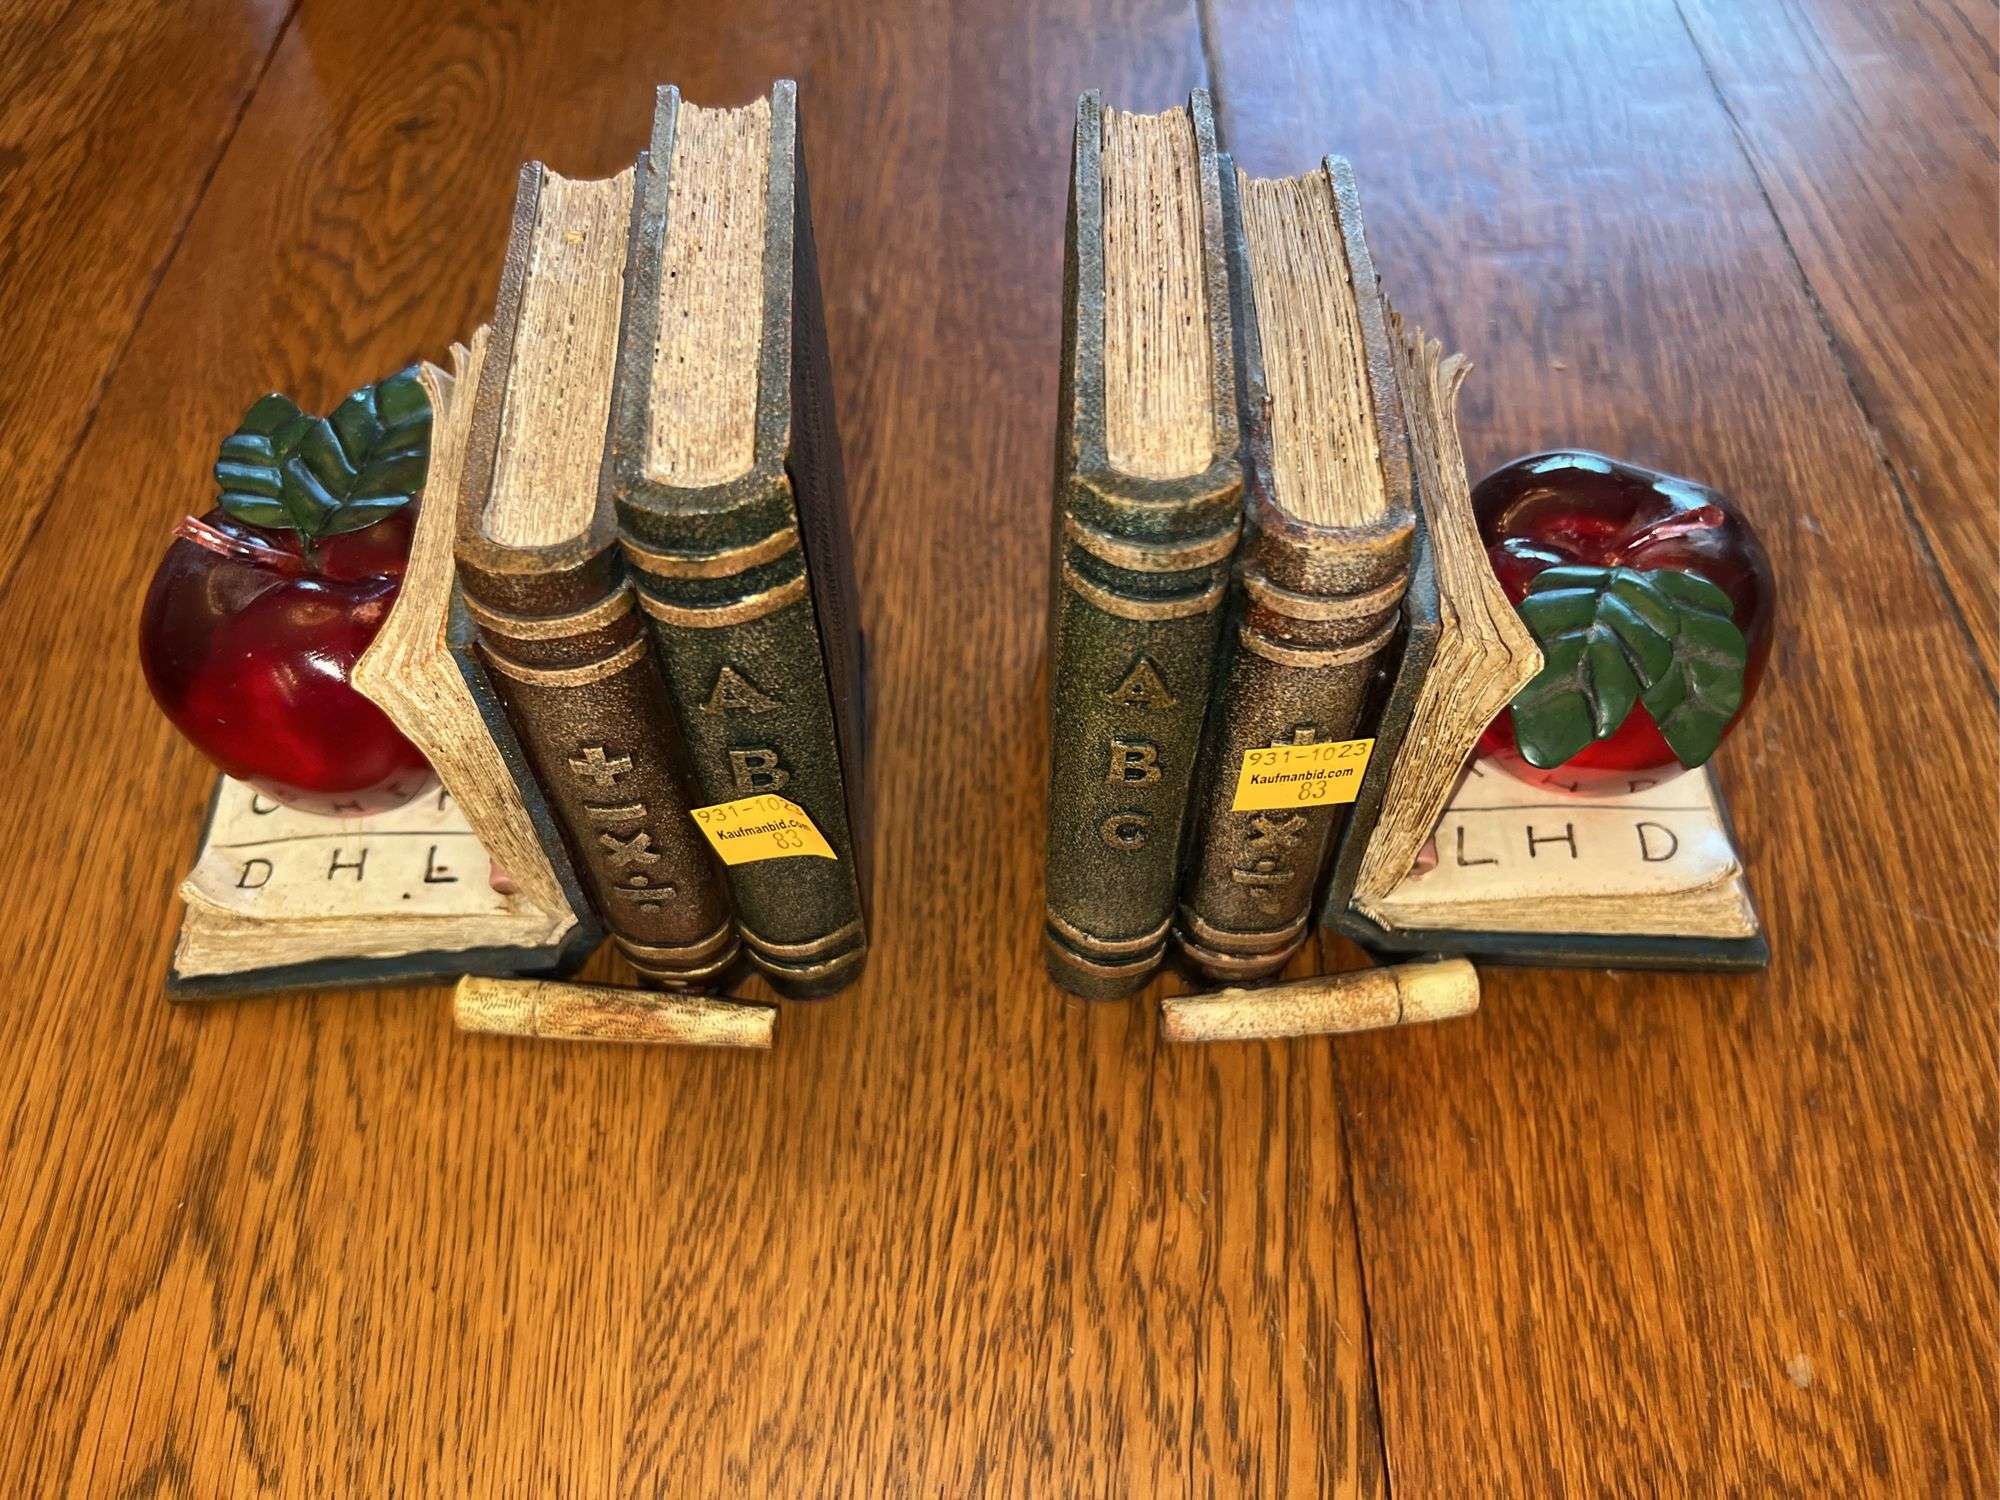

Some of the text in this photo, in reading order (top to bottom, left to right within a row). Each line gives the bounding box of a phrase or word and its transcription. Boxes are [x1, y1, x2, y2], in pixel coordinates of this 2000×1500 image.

[700, 665, 783, 715] A
[1104, 660, 1176, 710] A
[729, 749, 791, 792] B
[1107, 739, 1162, 787] B
[1248, 742, 1368, 767] 931-1023
[1250, 767, 1354, 785] Kaufmanbid.com
[1297, 780, 1328, 801] 83
[772, 828, 804, 850] 83
[1456, 821, 1679, 867] L H D
[235, 857, 275, 889] D
[327, 847, 369, 881] H
